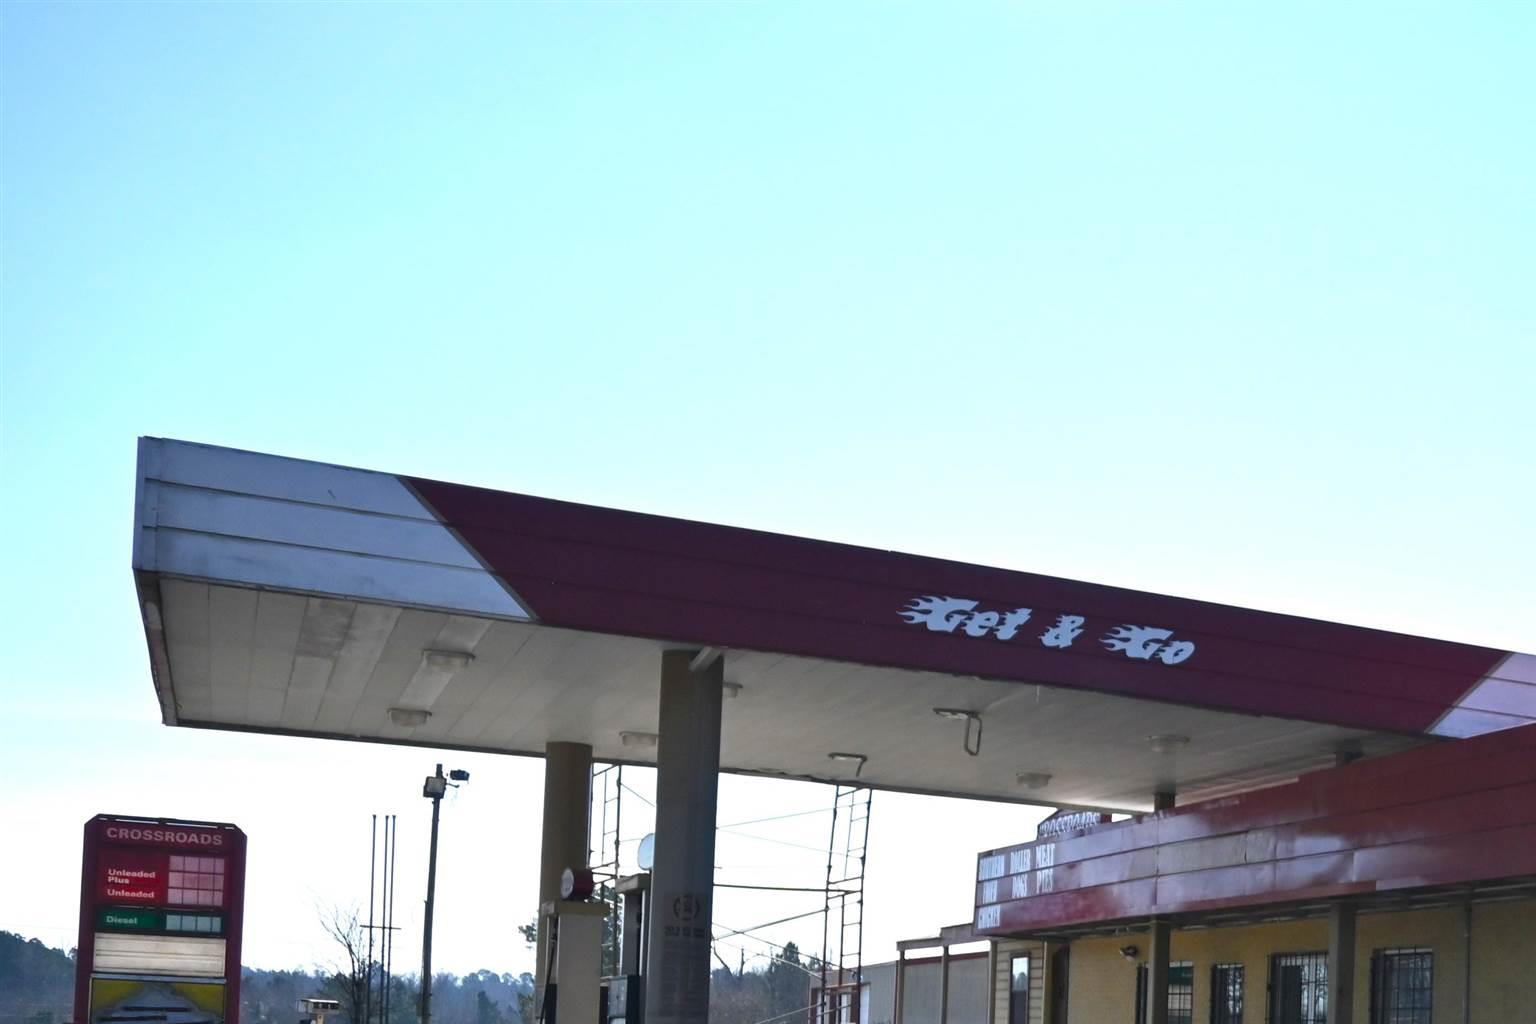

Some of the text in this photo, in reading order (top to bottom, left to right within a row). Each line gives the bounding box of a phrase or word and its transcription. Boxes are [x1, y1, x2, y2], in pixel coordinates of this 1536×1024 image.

[896, 595, 1195, 665] Get & Go
[106, 827, 223, 846] CROSSROADS
[1036, 843, 1056, 868] MEAT
[107, 876, 130, 885] Plus
[108, 868, 156, 879] Unleaded
[1036, 868, 1054, 894] PIES
[106, 889, 155, 899] Unleaded
[106, 915, 138, 925] Diesel
